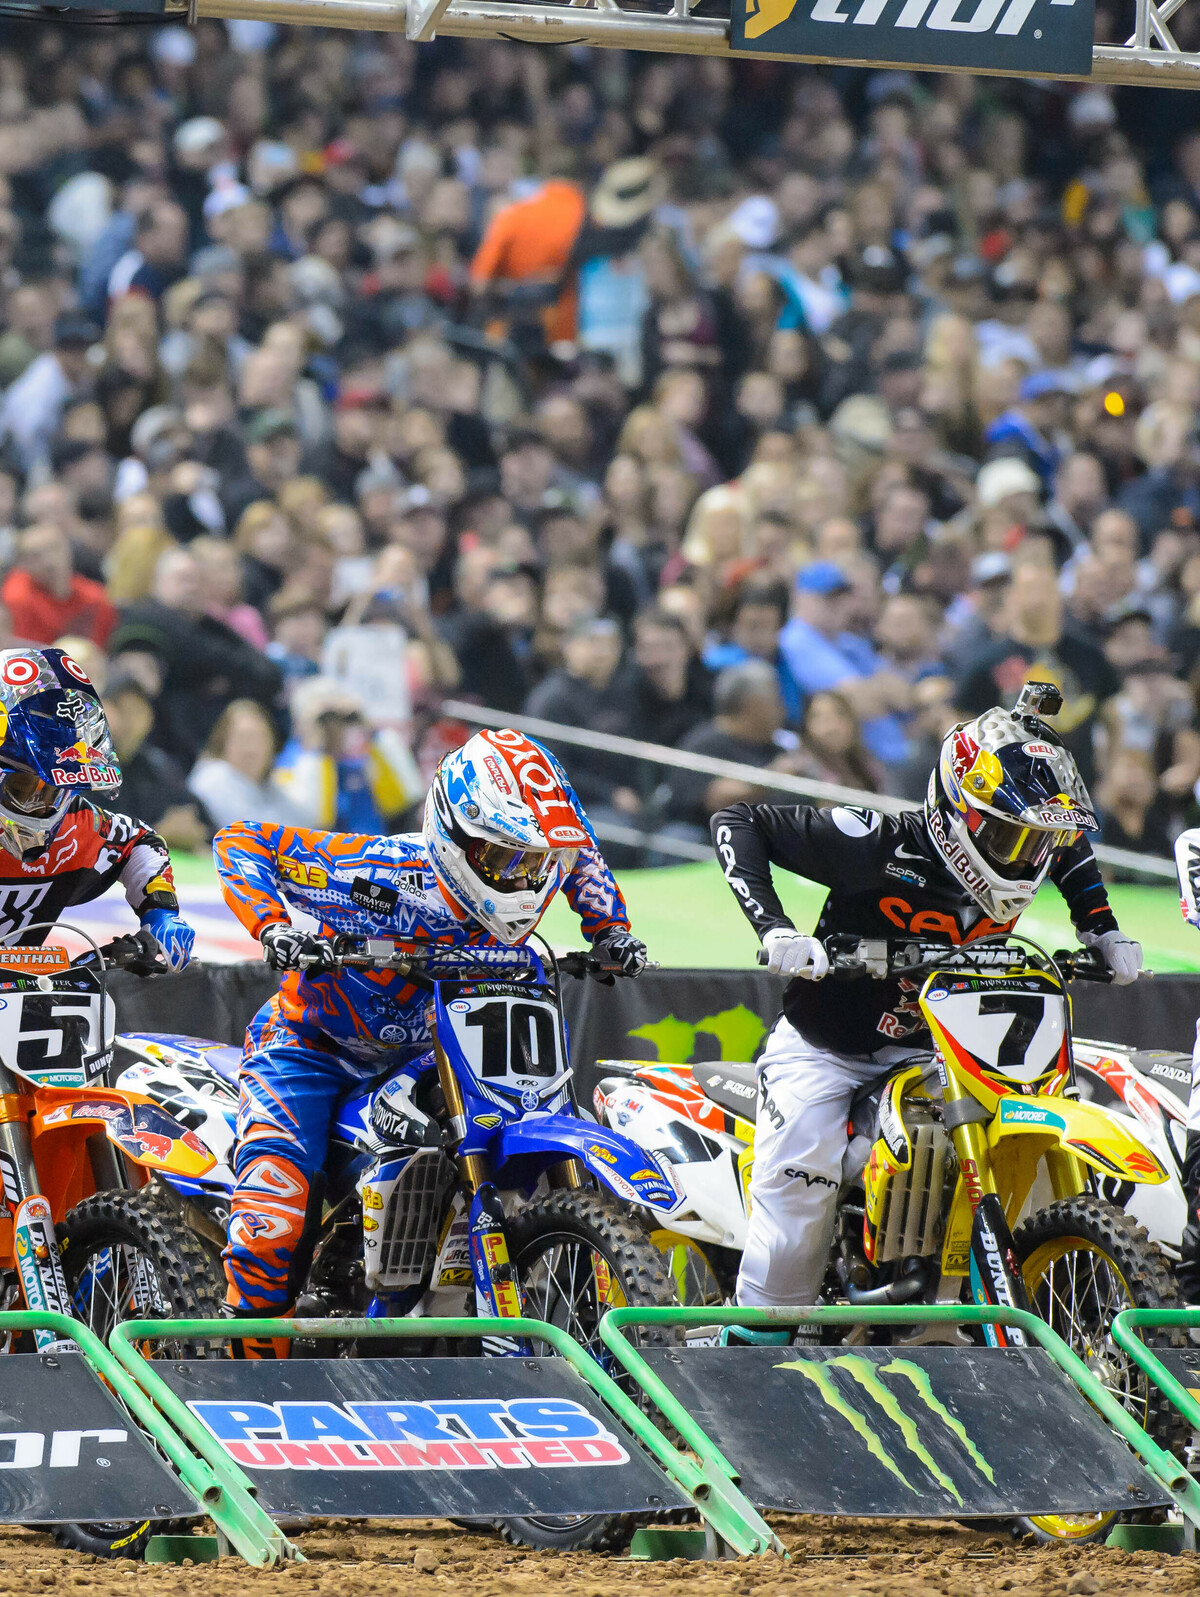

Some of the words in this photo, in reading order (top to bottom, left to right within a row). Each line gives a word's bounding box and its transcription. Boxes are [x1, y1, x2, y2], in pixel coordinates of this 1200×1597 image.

[1029, 746, 1053, 757] BELL
[53, 764, 89, 785] Red
[90, 765, 120, 784] Bull
[1040, 811, 1072, 824] Red
[1074, 811, 1099, 830] Bull
[555, 829, 581, 839] BELL
[930, 811, 960, 858] Red
[953, 850, 991, 898] Bull
[885, 862, 928, 884] GoPro
[353, 890, 391, 909] STRAYER
[394, 879, 427, 901] adidas
[522, 902, 536, 911] BELL
[486, 983, 528, 994] MONSTER
[980, 980, 1024, 989] MONSTER
[16, 994, 93, 1071] 5
[465, 1001, 557, 1078] 10
[978, 995, 1046, 1068] 7
[49, 1073, 84, 1084] MOTOREX
[1149, 1063, 1192, 1084] HONDA
[722, 1079, 758, 1100] SUZUKI
[373, 1104, 410, 1140] TOYOTA
[1013, 1110, 1047, 1123] MOTOREX
[611, 1170, 635, 1198] TOYOTA
[641, 1181, 673, 1191] YAMAHA
[192, 1402, 601, 1441] PARTS
[224, 1440, 624, 1467] UNLIMITED
